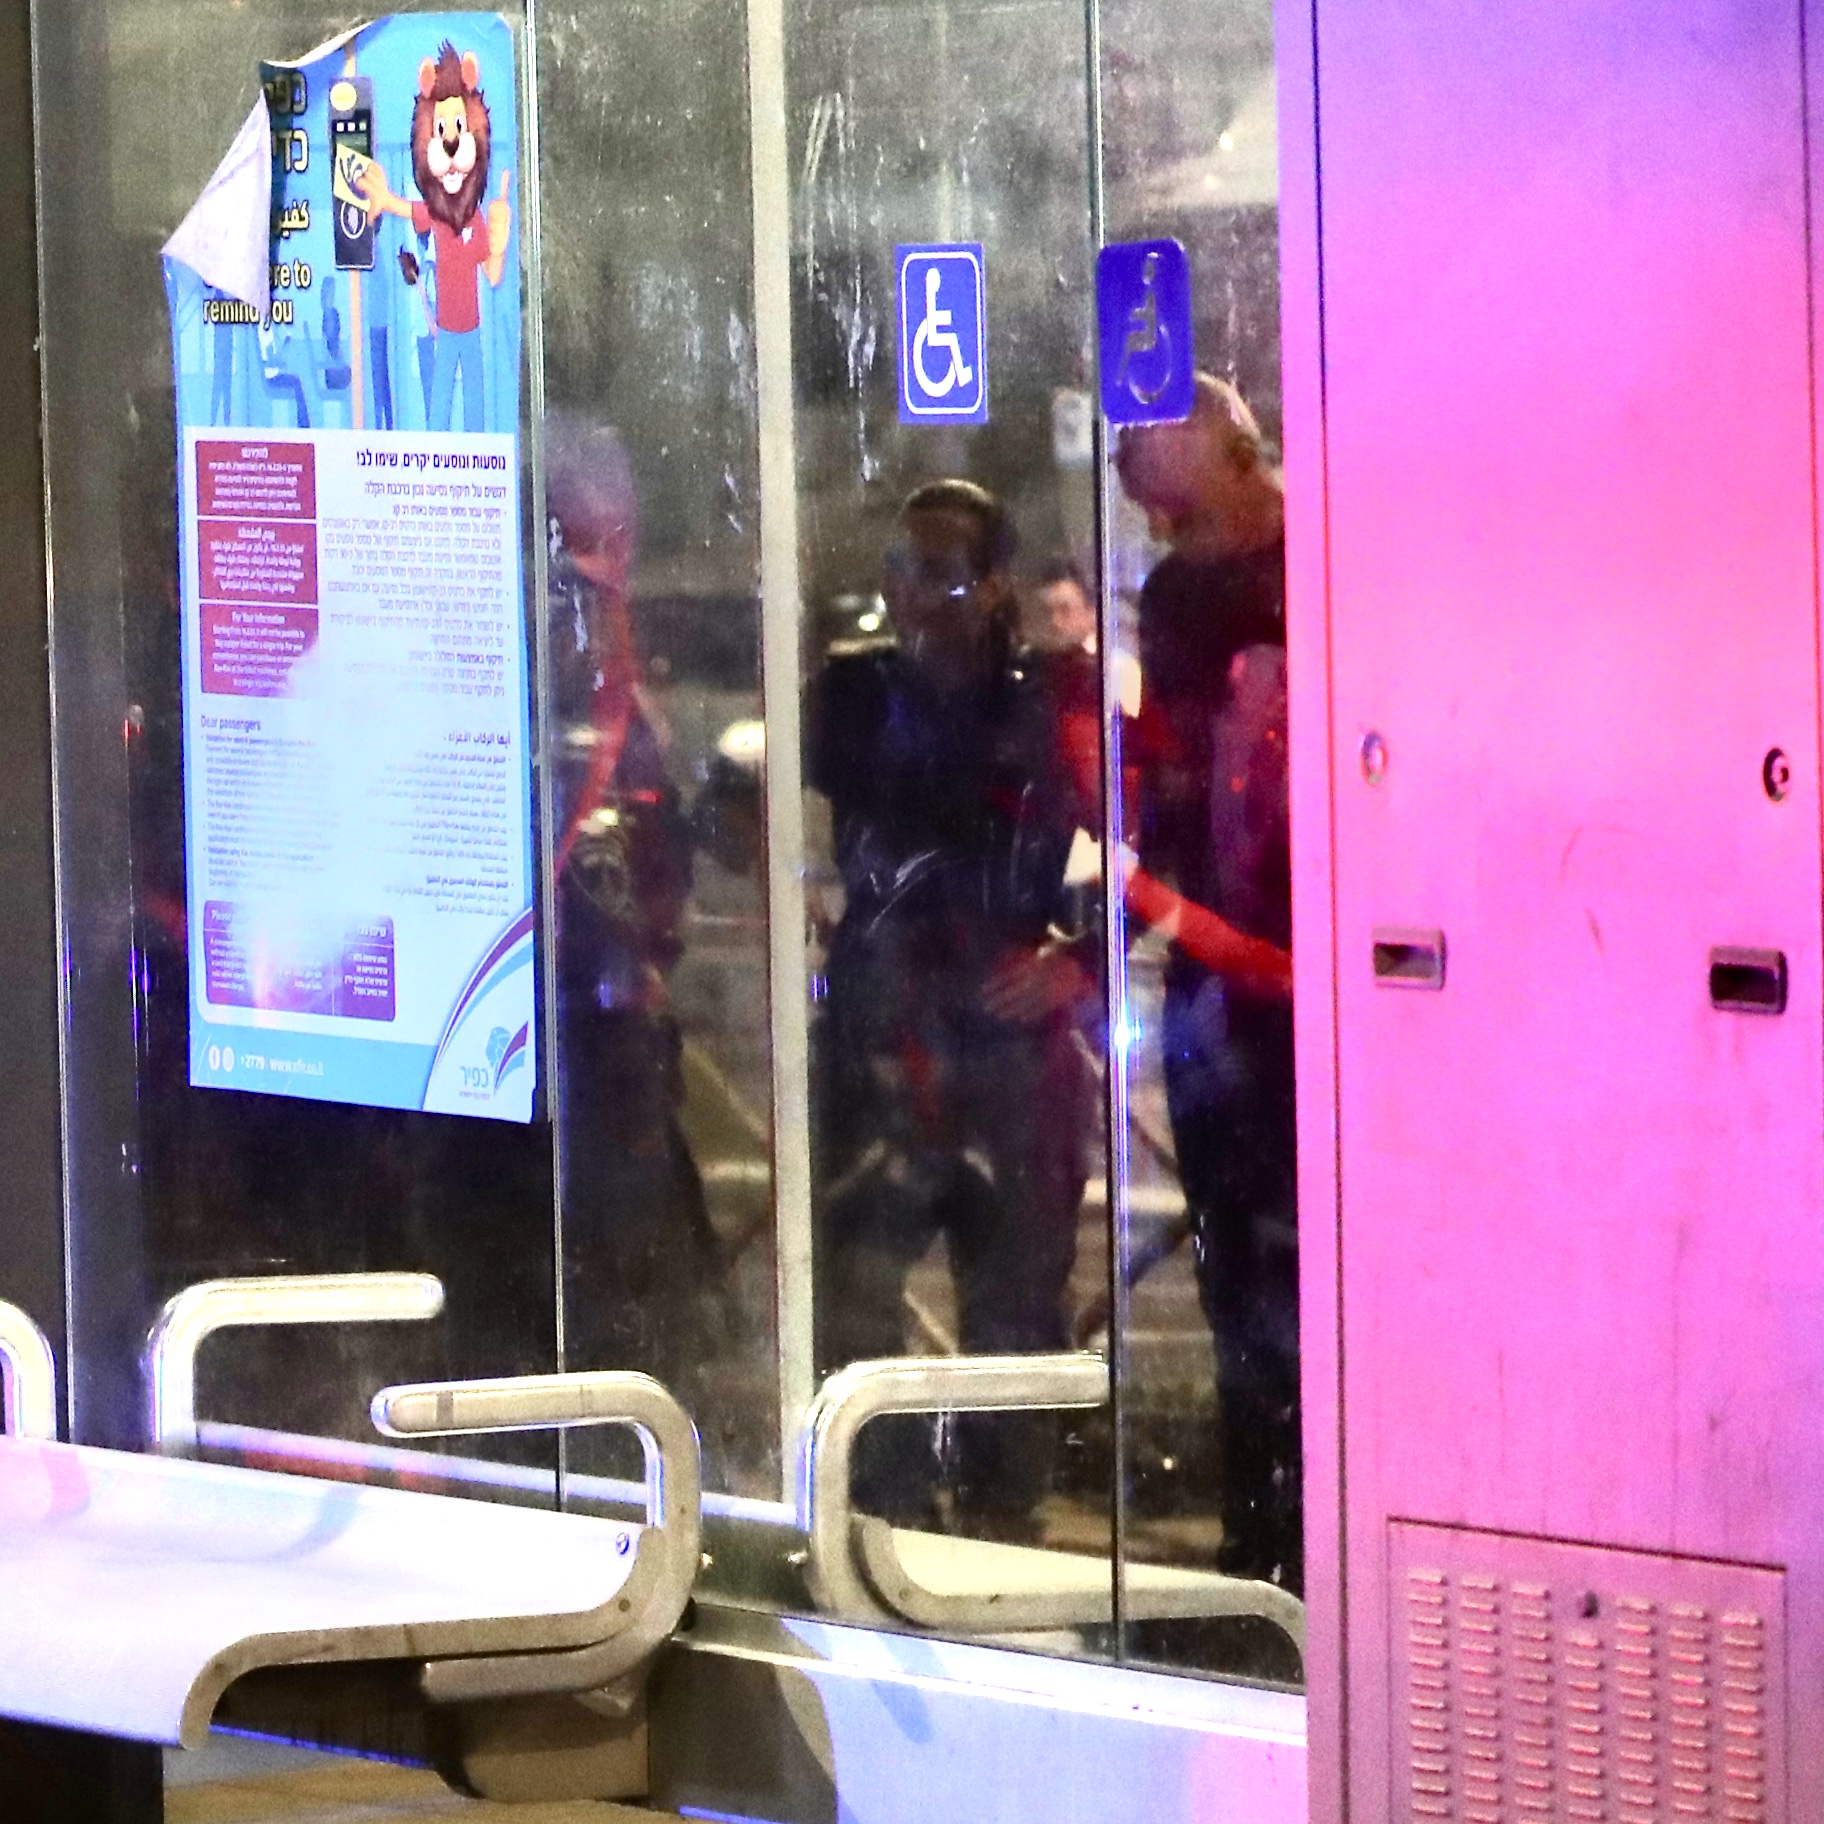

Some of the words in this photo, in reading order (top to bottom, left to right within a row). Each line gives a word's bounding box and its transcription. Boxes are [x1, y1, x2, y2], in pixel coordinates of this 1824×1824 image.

[279, 200, 311, 238] كفي
[293, 258, 312, 288] to
[263, 299, 294, 331] ou
[356, 448, 372, 467] לב!
[375, 451, 399, 467] שימו
[433, 453, 470, 469] ונוסעים
[472, 454, 507, 470] נוסעות
[459, 1065, 489, 1088] כפיר
